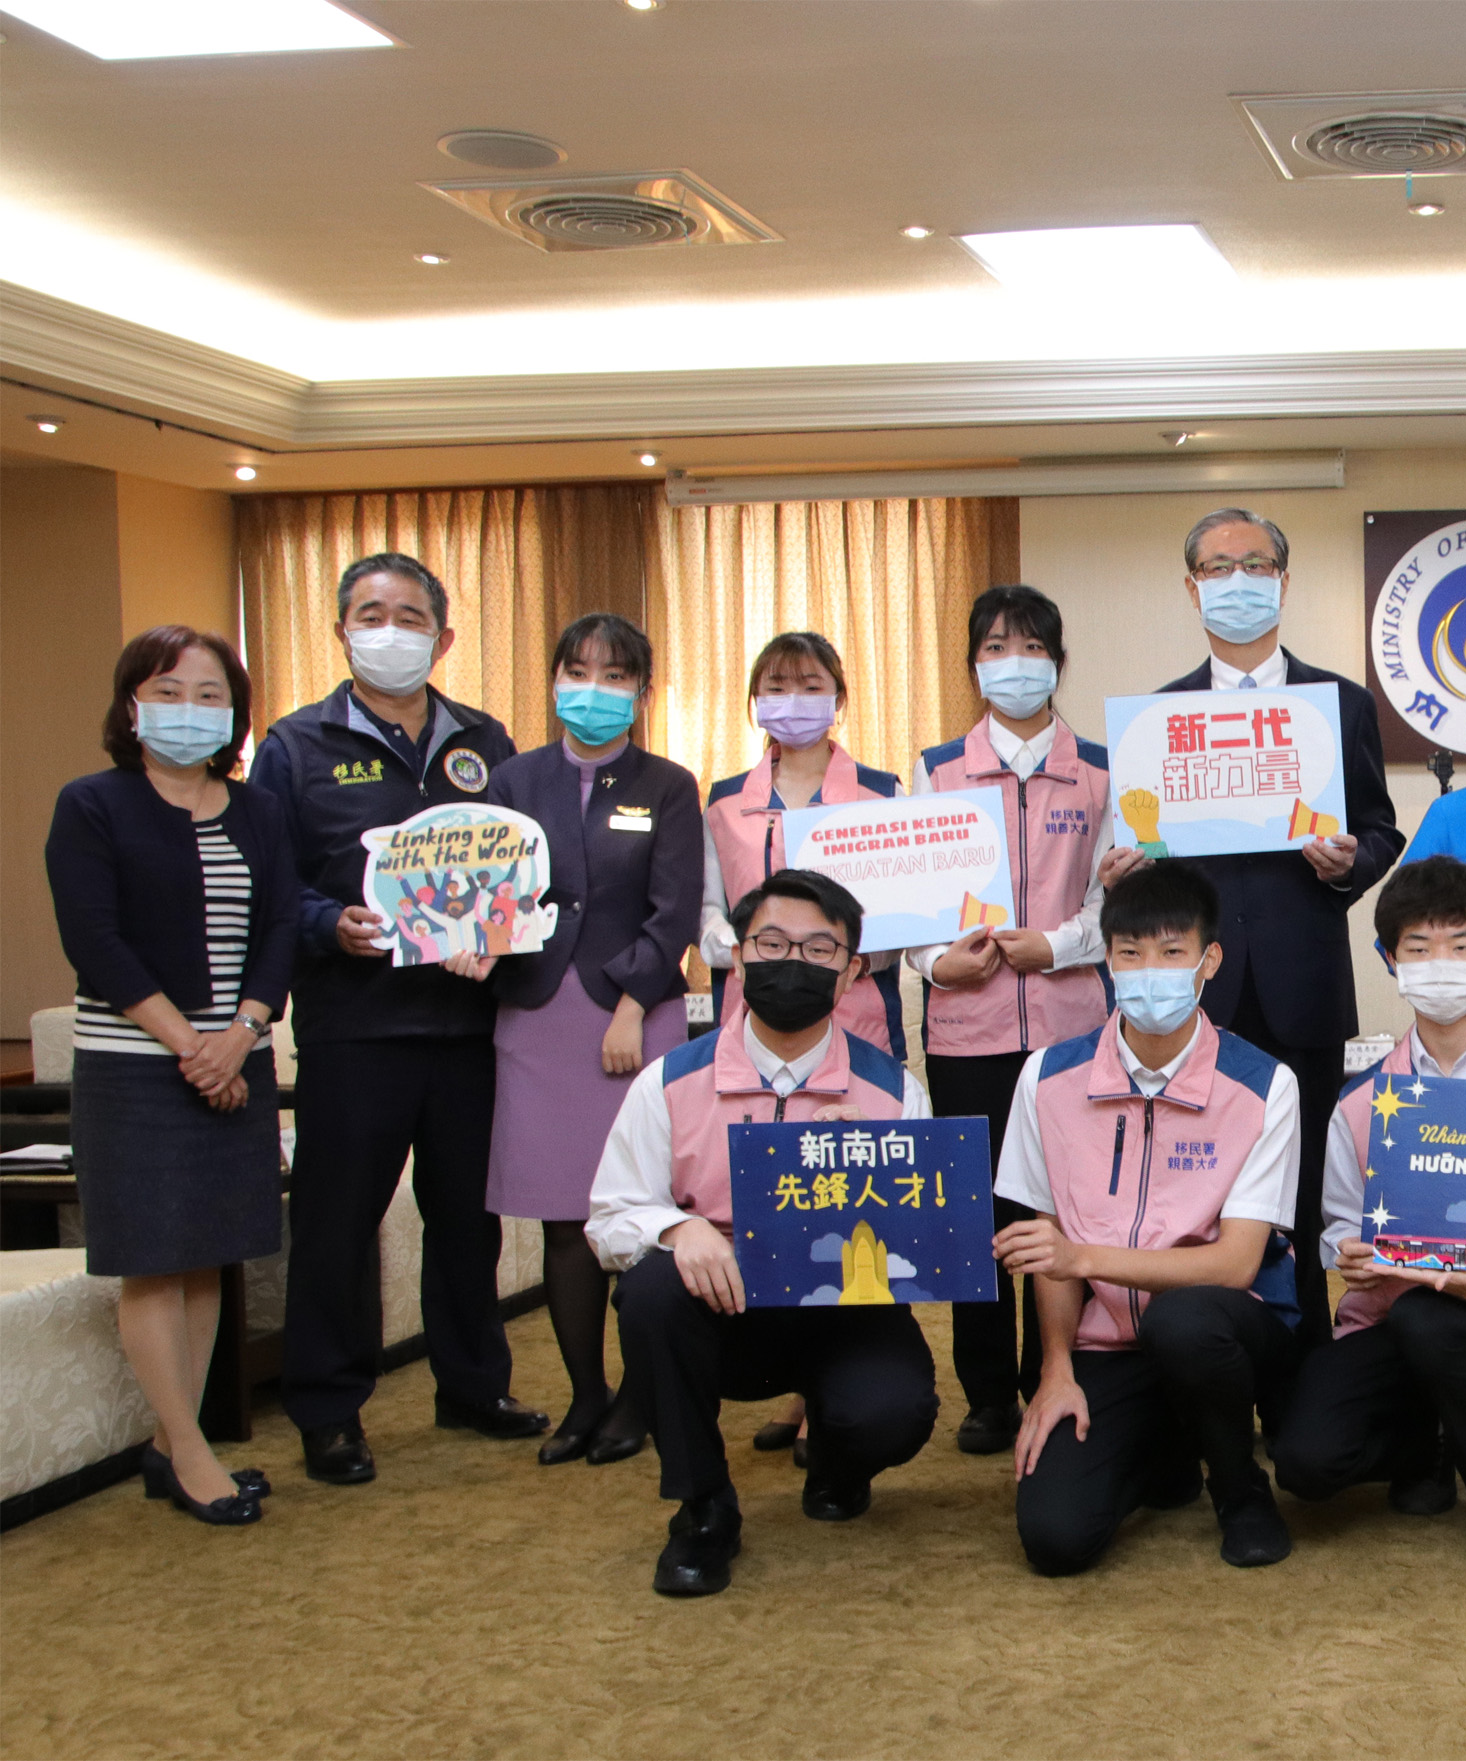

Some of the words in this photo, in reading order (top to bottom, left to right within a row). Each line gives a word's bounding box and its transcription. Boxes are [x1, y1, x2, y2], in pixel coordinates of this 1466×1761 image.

[1381, 556, 1423, 682] MINISTRY
[1166, 707, 1293, 754] 新二代
[332, 759, 384, 779] 移民署
[1162, 749, 1302, 803] 新力量
[390, 826, 473, 849] Linking
[482, 825, 510, 845] up
[811, 821, 907, 842] GENERASI
[912, 812, 978, 831] KEDUA
[823, 836, 910, 857] IMIGRAN
[914, 828, 970, 846] BARU
[375, 849, 425, 872] with
[433, 845, 469, 866] the
[478, 837, 539, 861] World
[810, 853, 927, 882] KUATAN
[932, 845, 996, 872] BARU
[799, 1128, 915, 1170] 新南向
[1167, 1156, 1219, 1171] 親善大使
[1174, 1141, 1216, 1156] 移民署
